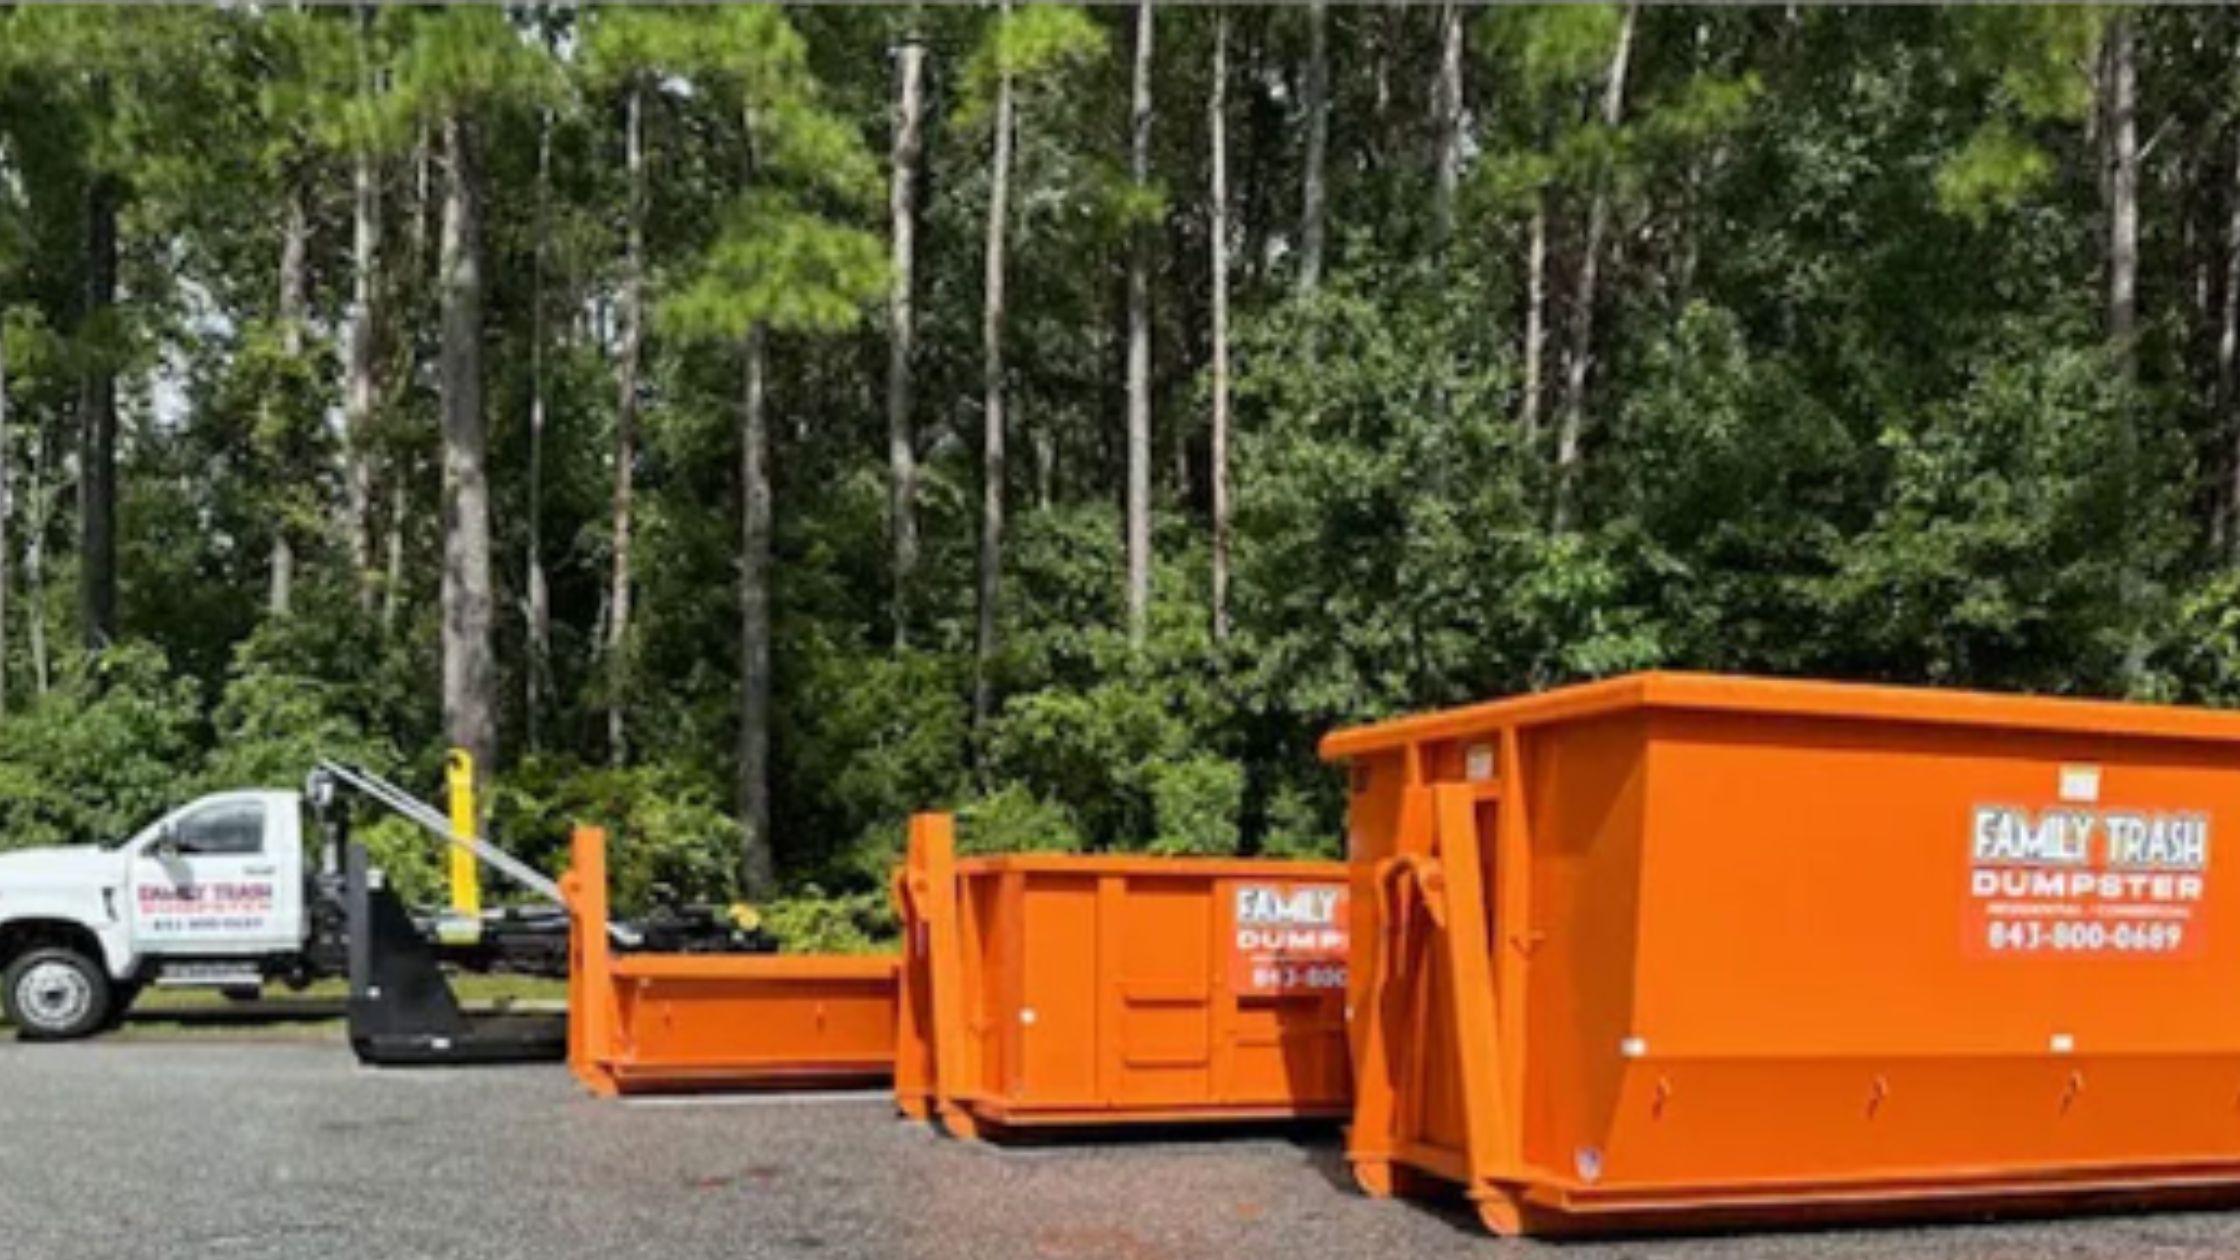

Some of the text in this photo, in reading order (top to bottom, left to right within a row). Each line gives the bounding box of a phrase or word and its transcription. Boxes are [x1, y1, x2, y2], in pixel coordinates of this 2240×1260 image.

[1973, 808, 2207, 865] FAMILY TRASH
[1972, 870, 2203, 899] DUMPSTER
[1237, 887, 1338, 924] FAMILY
[1237, 929, 1349, 950] DUMP
[1988, 920, 2182, 949] 843-800-0689
